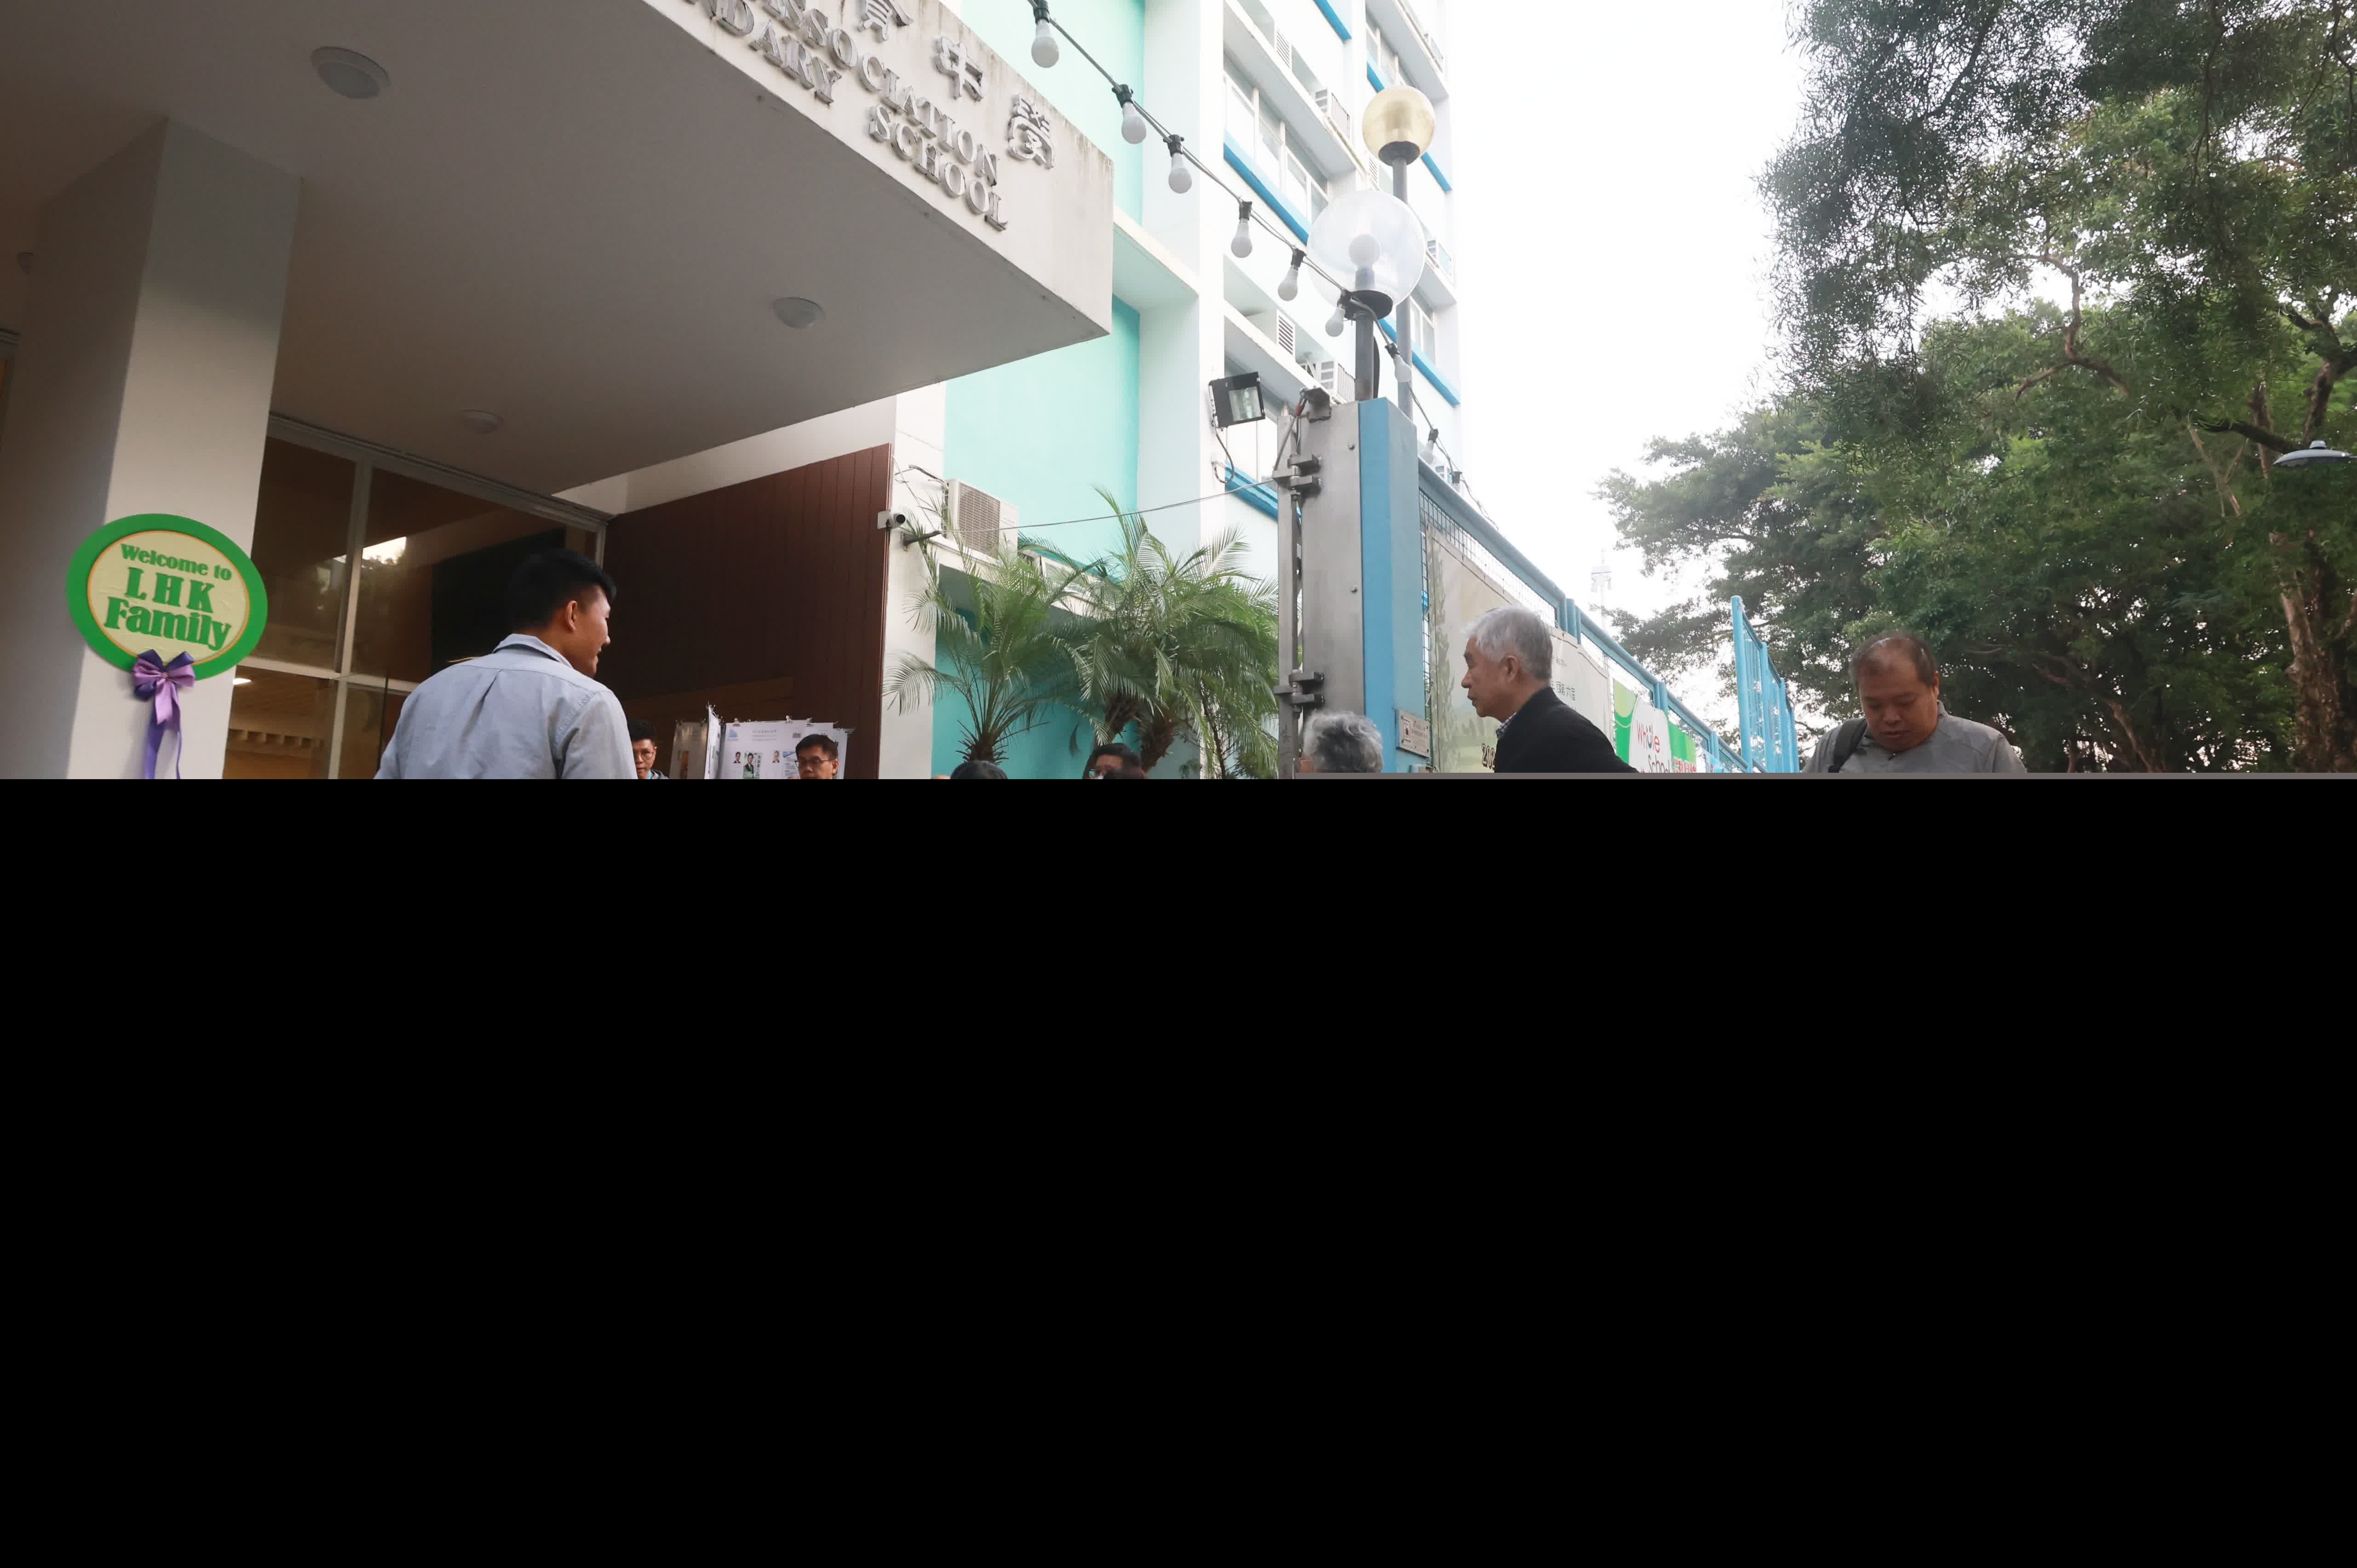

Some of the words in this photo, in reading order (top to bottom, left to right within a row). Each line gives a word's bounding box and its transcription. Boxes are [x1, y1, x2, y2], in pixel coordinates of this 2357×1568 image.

[868, 103, 1007, 231] SCHOOL
[121, 543, 208, 576] Welcome
[214, 564, 232, 581] to
[104, 596, 231, 651] Family
